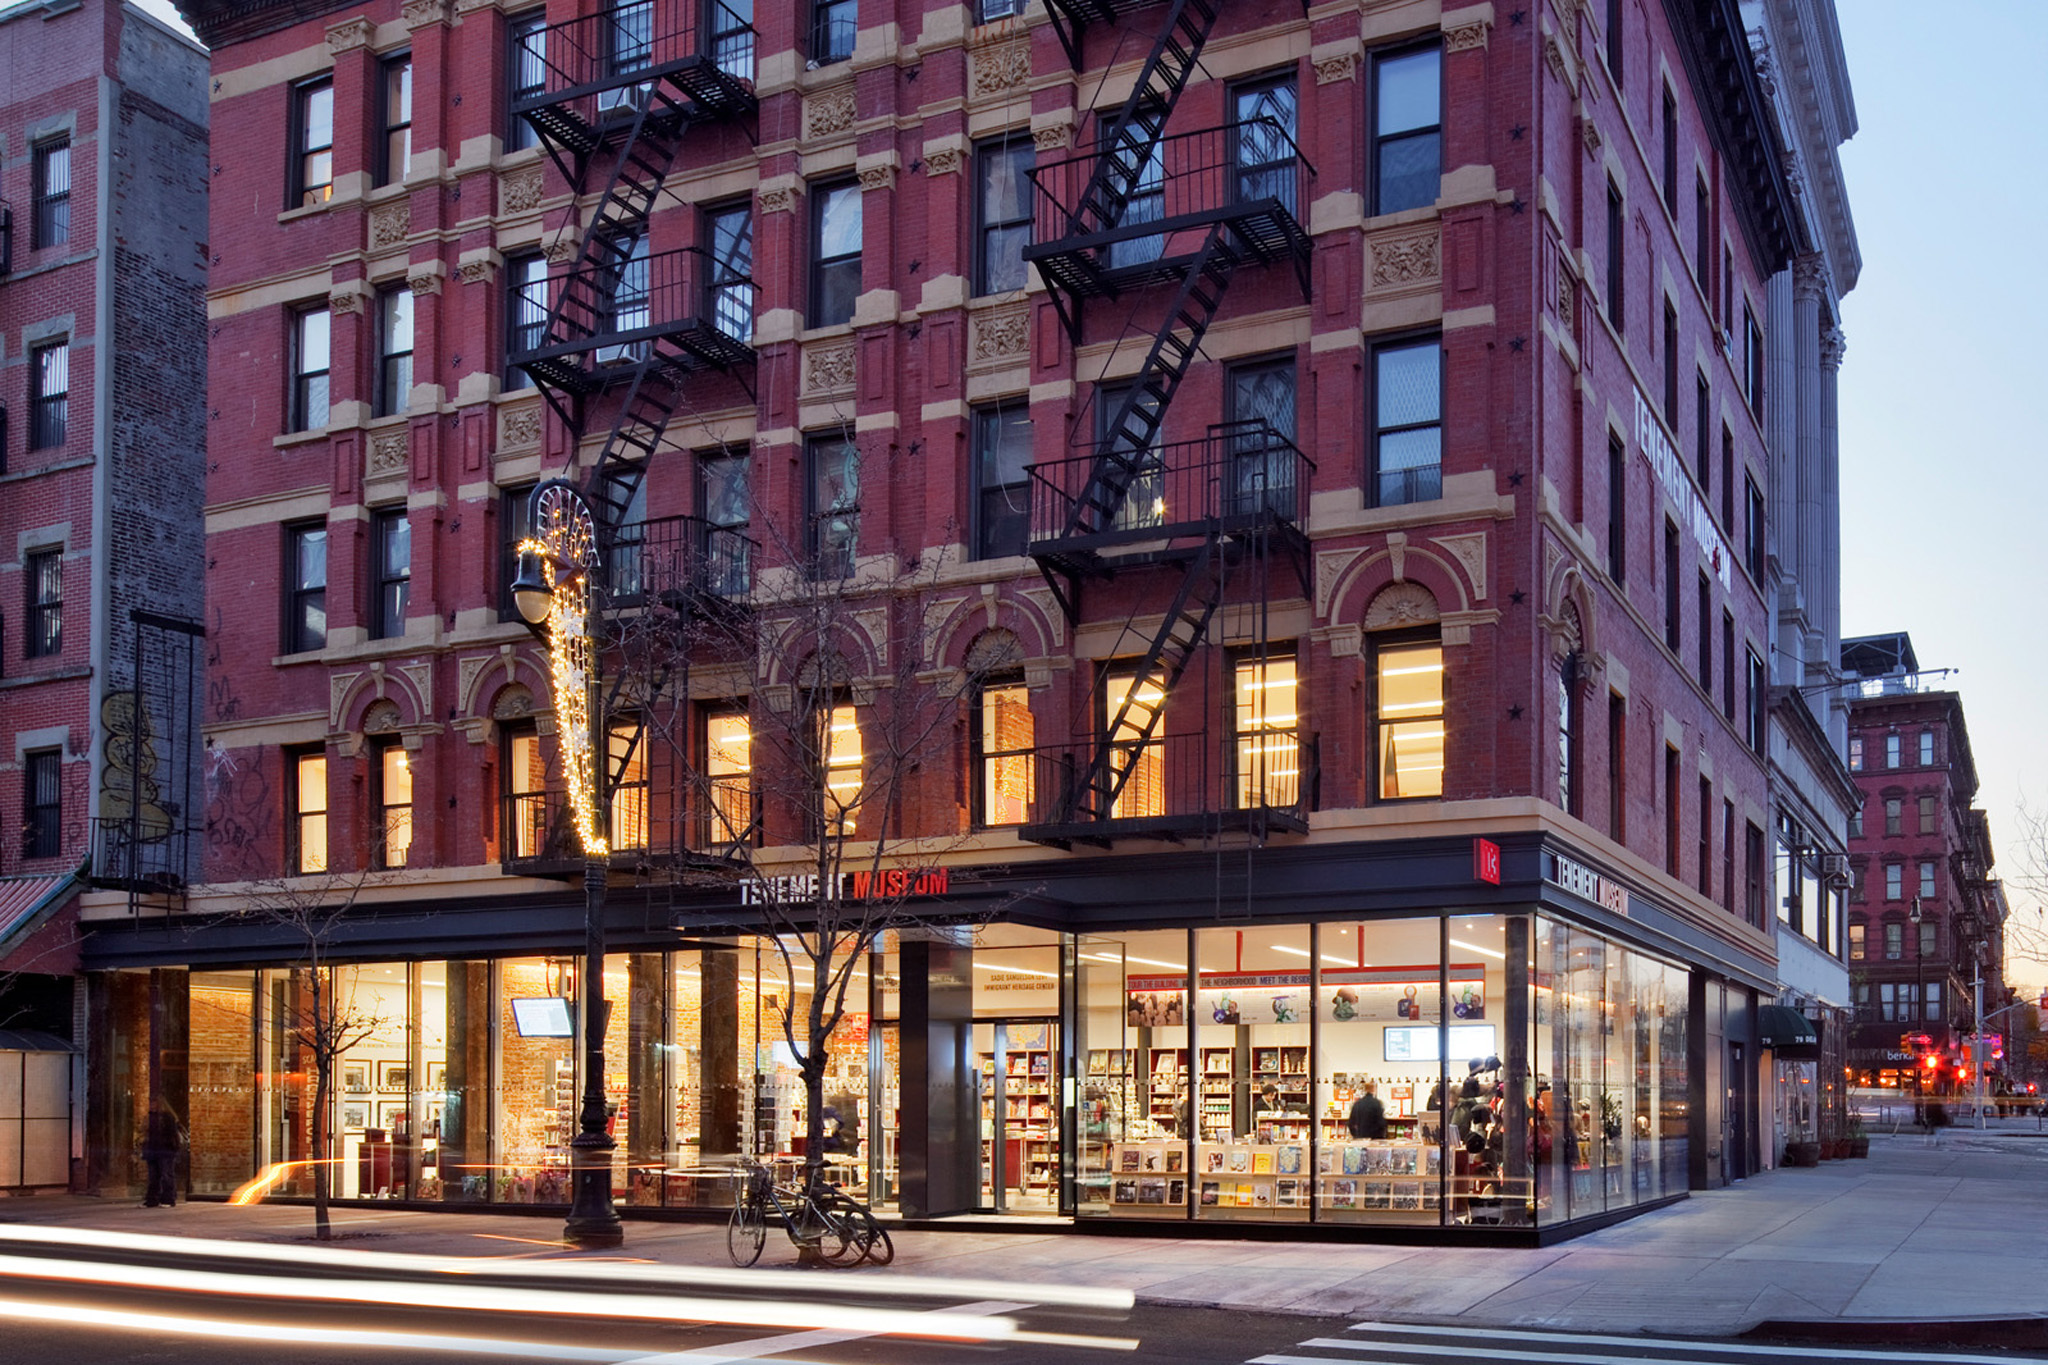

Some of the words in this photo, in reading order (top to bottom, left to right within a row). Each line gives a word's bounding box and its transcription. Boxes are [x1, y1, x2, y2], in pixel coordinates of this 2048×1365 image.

[1633, 384, 1691, 527] TENEMENT
[1556, 854, 1598, 902] TENEMENT
[1600, 876, 1629, 916] MUSEUM
[1154, 978, 1179, 988] BUILDING
[1201, 978, 1212, 987] THE
[1213, 977, 1257, 986] NEIGHBORHOOD
[1260, 976, 1276, 985] MEET
[1278, 975, 1290, 984] THE
[983, 983, 1011, 992] IMMIGRANT
[1036, 982, 1055, 990] CENTER
